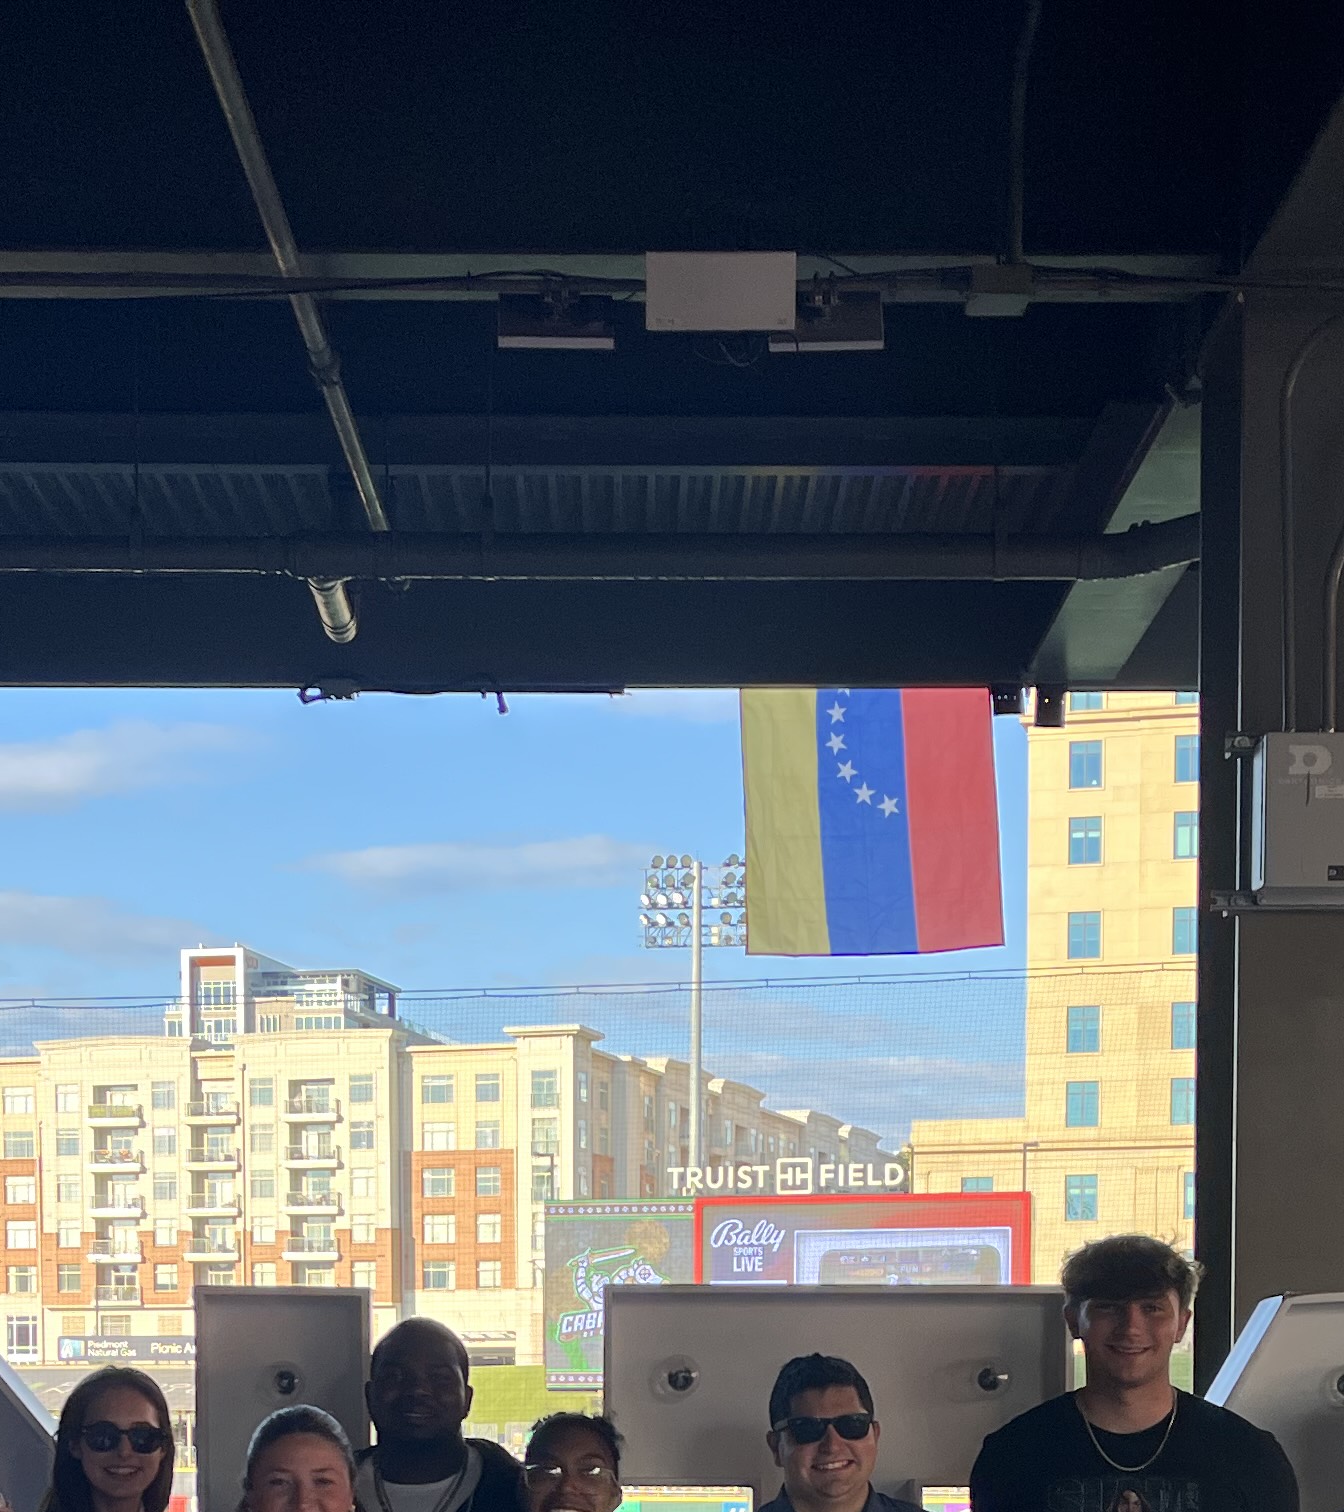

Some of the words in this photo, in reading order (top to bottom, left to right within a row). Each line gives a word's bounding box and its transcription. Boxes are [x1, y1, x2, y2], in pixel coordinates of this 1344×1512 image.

[666, 1165, 770, 1190] TRUIST
[818, 1162, 905, 1188] FIELD
[710, 1218, 786, 1252] Bally
[732, 1246, 764, 1257] SPORTS
[732, 1255, 764, 1274] LIVE
[87, 1349, 119, 1357] Natural
[120, 1349, 137, 1357] Gas
[150, 1342, 183, 1354] Picnic
